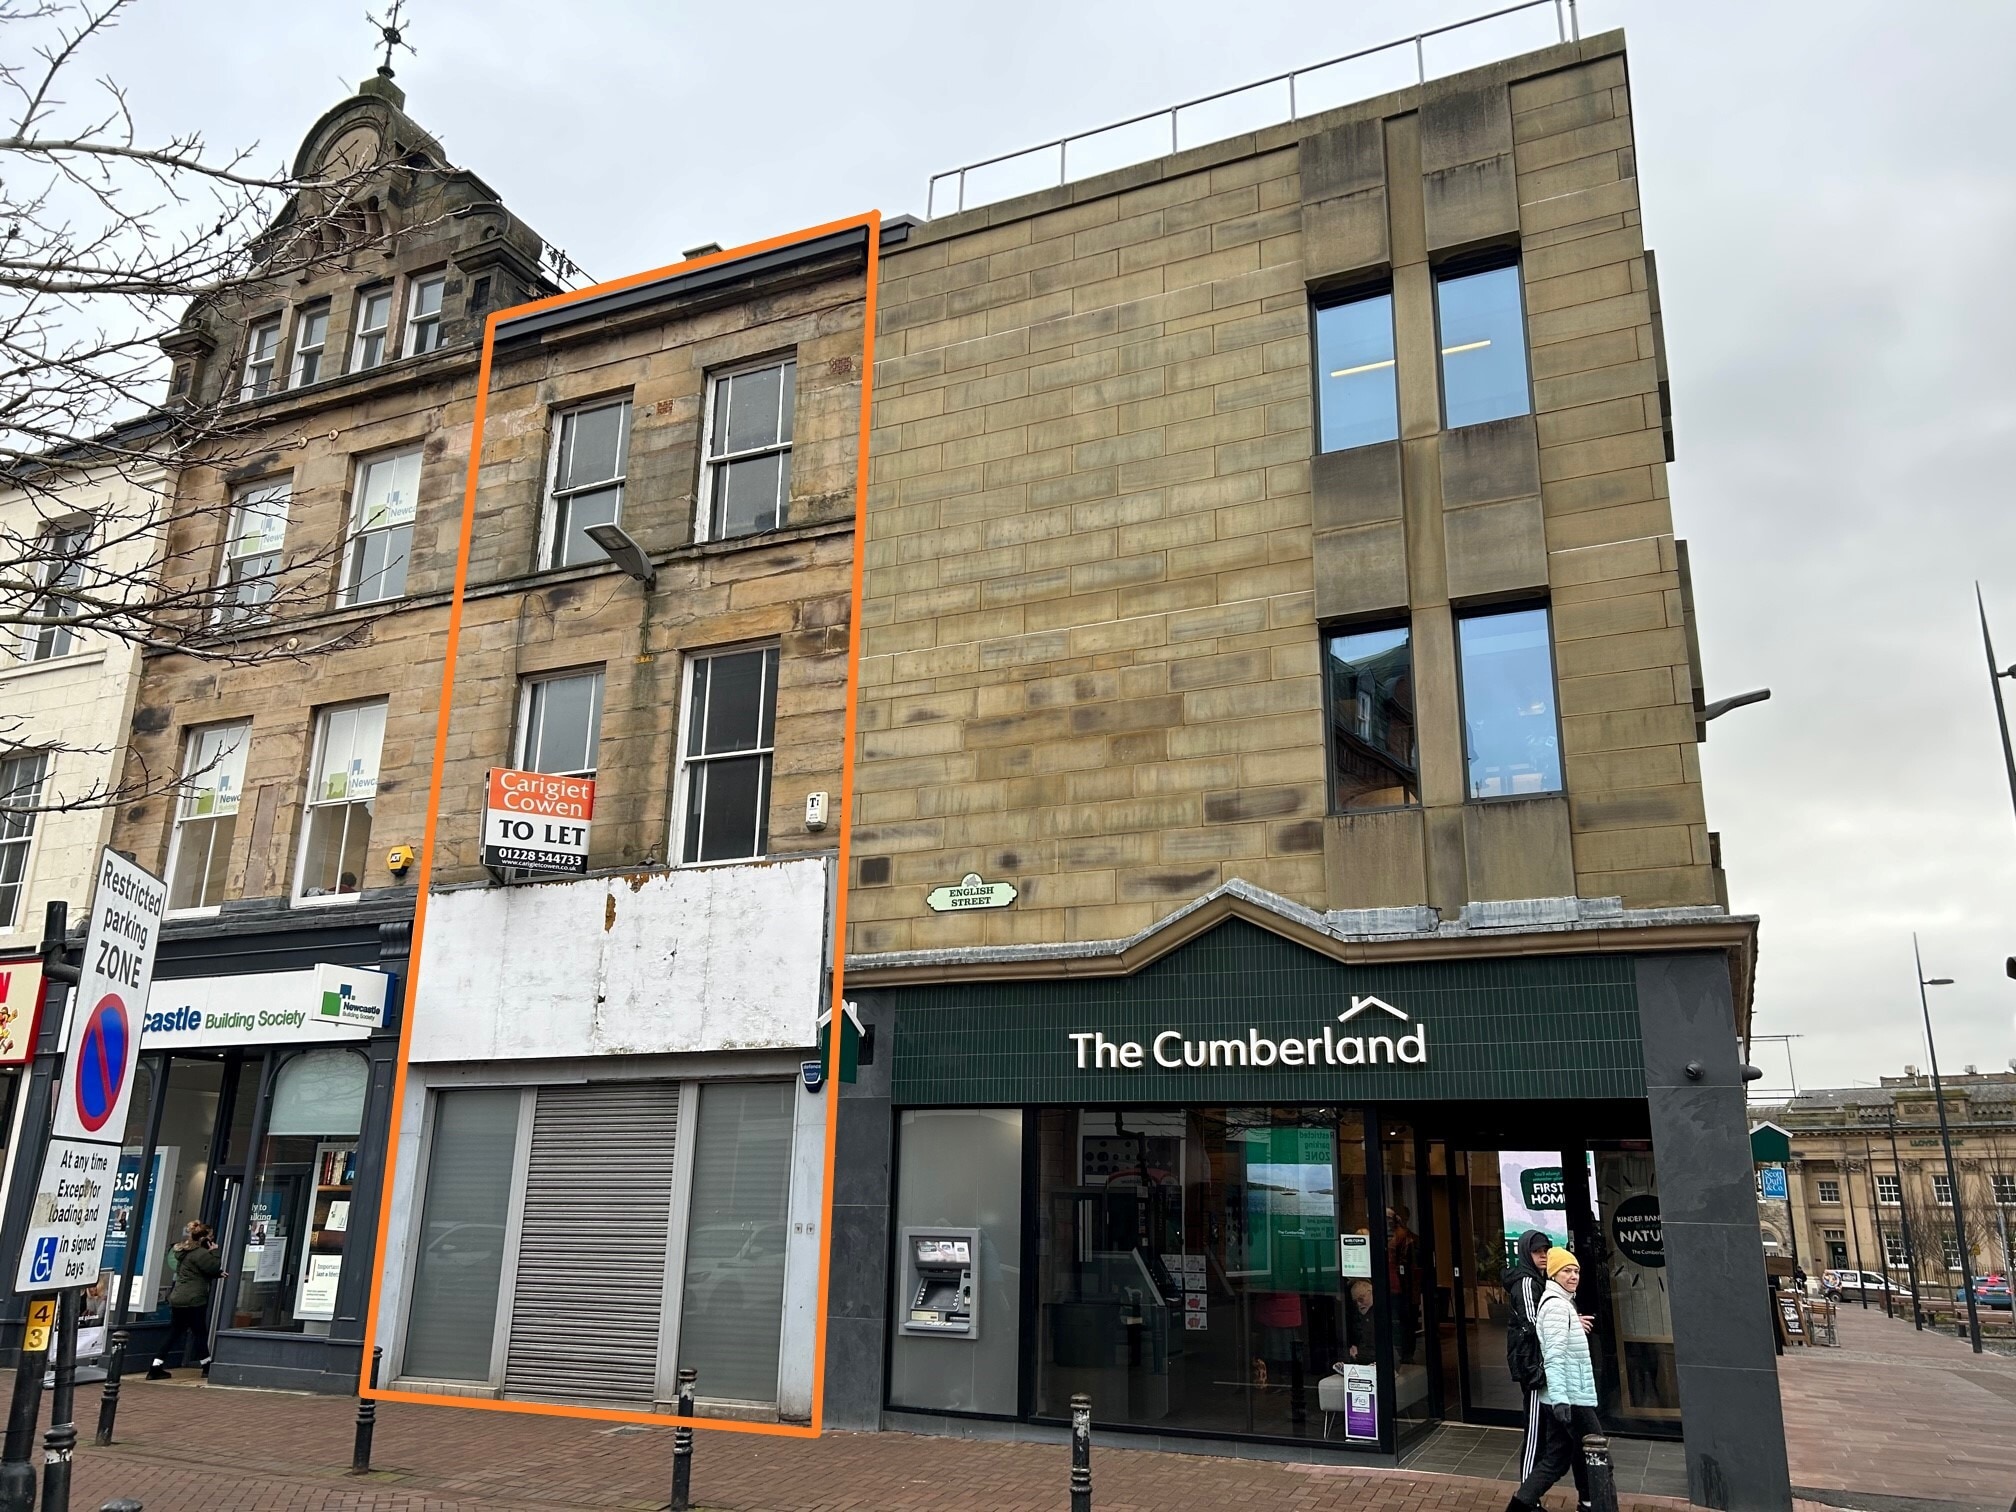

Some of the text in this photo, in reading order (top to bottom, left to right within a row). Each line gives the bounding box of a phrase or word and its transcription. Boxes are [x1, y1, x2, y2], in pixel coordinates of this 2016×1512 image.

[500, 772, 589, 801] Carigiet
[503, 791, 582, 817] Cowen
[498, 819, 586, 846] TO LET
[498, 848, 582, 866] 01228 544733
[102, 858, 164, 917] Restricted
[949, 886, 995, 898] ENGLISH
[951, 896, 992, 907] STREET
[102, 906, 149, 951] parking
[95, 939, 143, 989] ZONE
[343, 1000, 381, 1015] Newcastle
[205, 1012, 255, 1031] Building
[257, 1009, 306, 1029] Society
[1068, 1022, 1428, 1069] The Cumberland
[1909, 1139, 1940, 1147] LLOYDS
[60, 1149, 108, 1173] At any time
[1763, 1169, 1783, 1178] Scott
[1765, 1176, 1783, 1185] Duff
[90, 1180, 102, 1198] for
[1533, 1182, 1564, 1194] FIRST
[1530, 1193, 1566, 1205] HOM
[48, 1203, 100, 1226] loading and
[1616, 1214, 1662, 1223] KINDER BAN
[59, 1233, 98, 1256] in signed
[1619, 1229, 1664, 1243] NATU
[64, 1258, 85, 1280] bays
[34, 1304, 50, 1323] 4
[28, 1328, 43, 1348] 3
